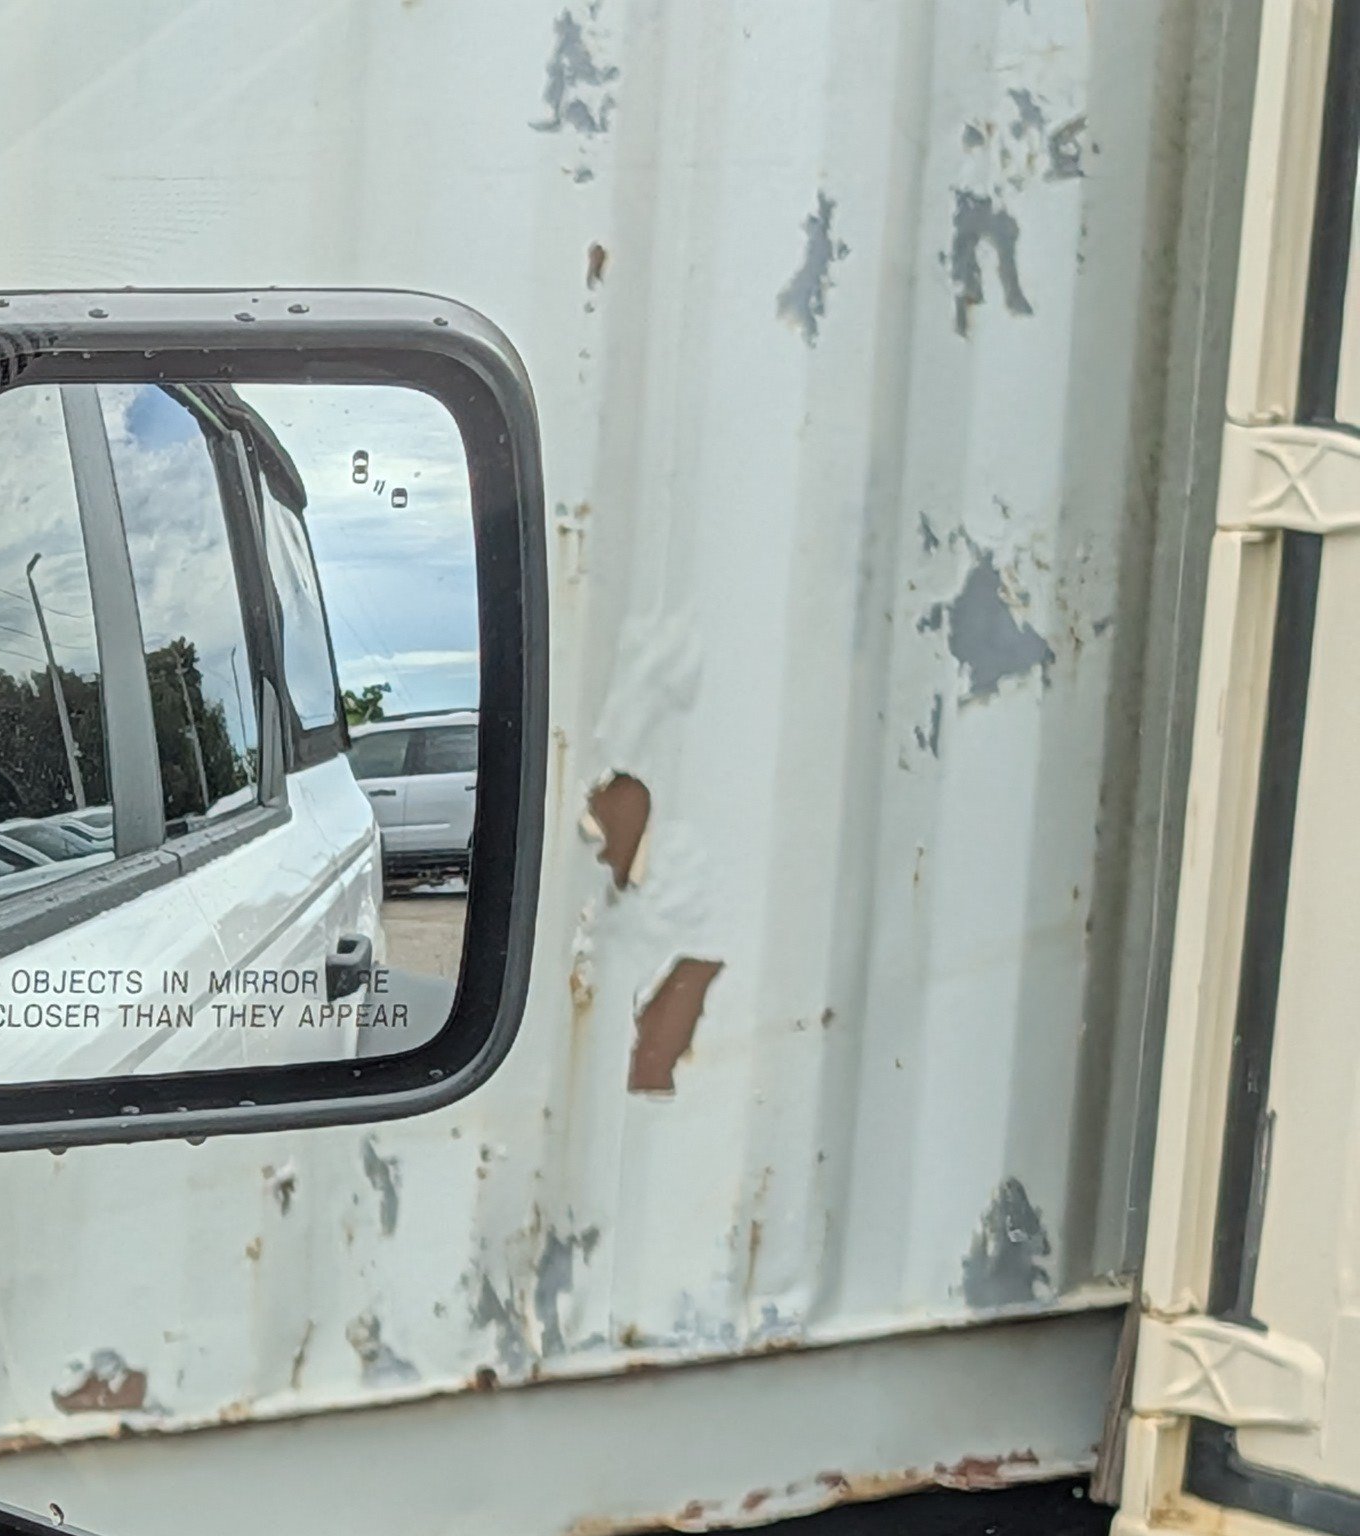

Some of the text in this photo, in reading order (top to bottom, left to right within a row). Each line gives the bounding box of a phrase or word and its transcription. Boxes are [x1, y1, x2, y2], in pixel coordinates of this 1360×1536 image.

[11, 969, 143, 995] OBJECTS
[162, 969, 189, 995] IN
[209, 969, 318, 995] MIRROR
[118, 1003, 194, 1029] THAN
[211, 1003, 284, 1028] THEY
[298, 1003, 409, 1028] APPEAR
